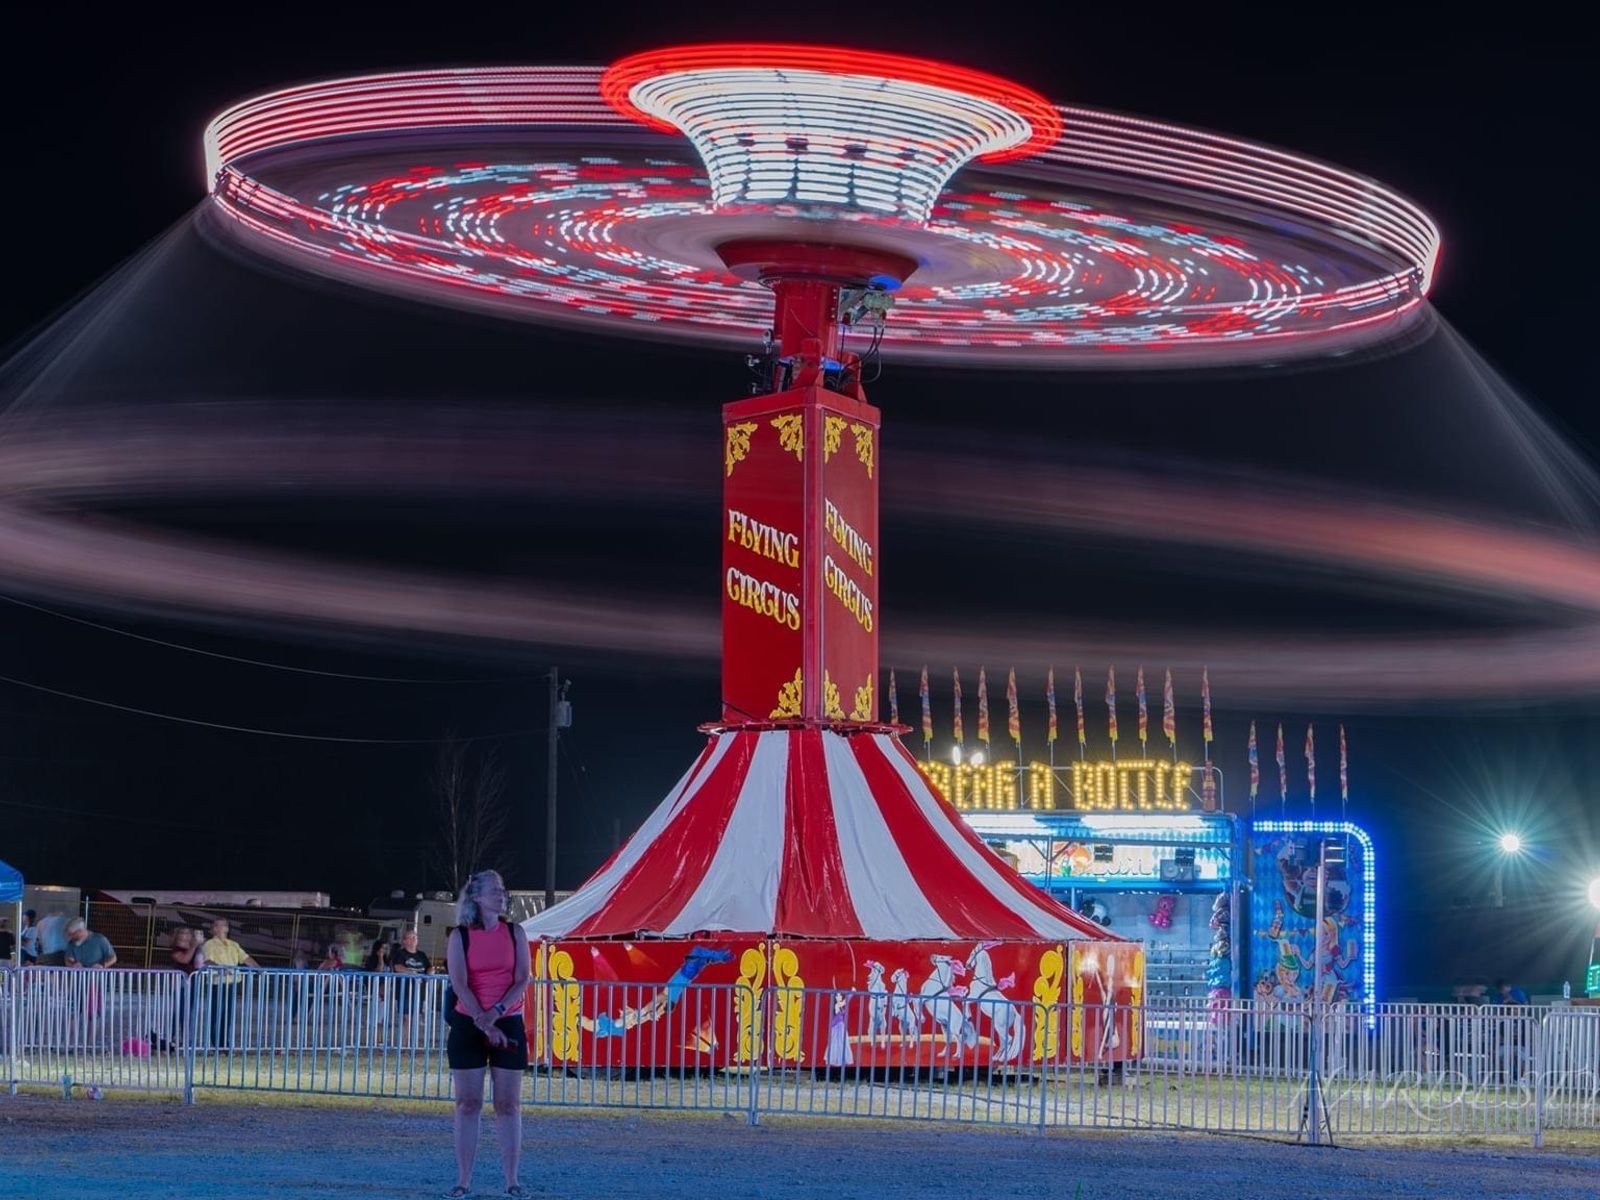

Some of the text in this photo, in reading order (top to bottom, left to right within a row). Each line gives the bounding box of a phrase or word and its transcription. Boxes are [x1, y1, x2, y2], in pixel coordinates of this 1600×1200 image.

[728, 509, 800, 568] FLYING
[825, 497, 873, 577] FLYING
[726, 567, 800, 630] CIRCUS
[825, 555, 873, 632] CIRCUS
[1029, 760, 1056, 810] A
[1072, 759, 1193, 811] BOTTLE
